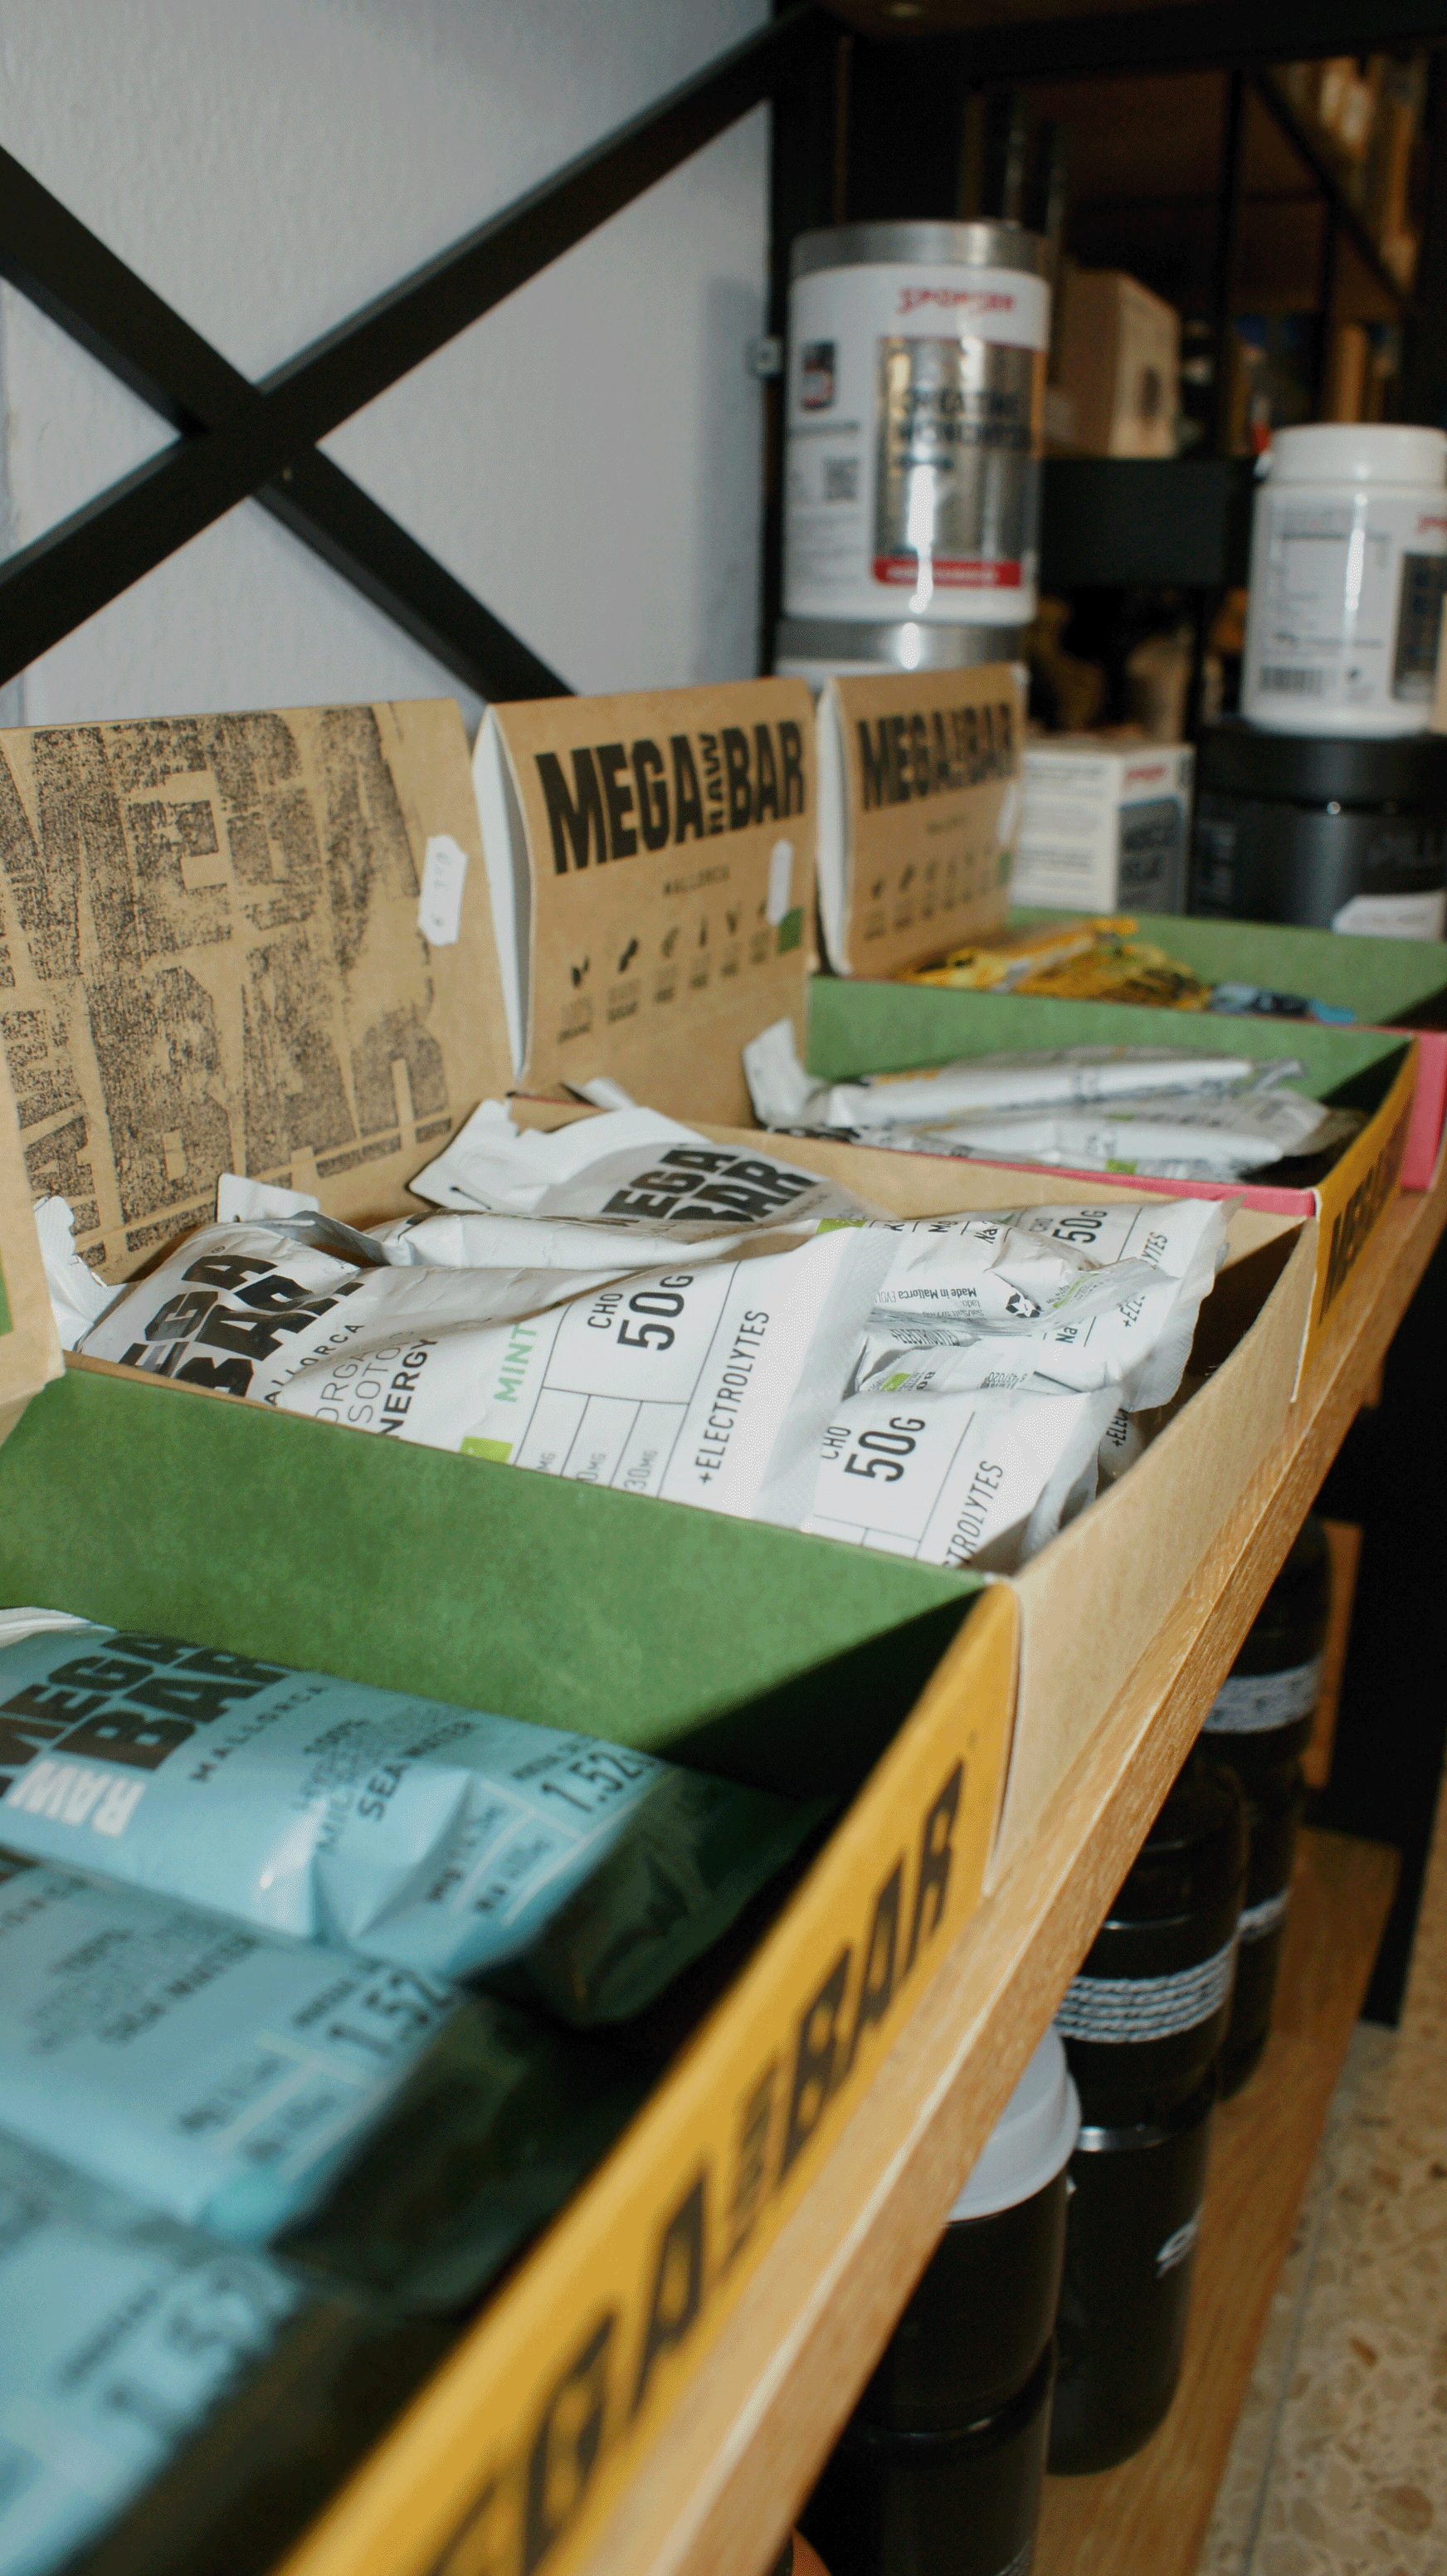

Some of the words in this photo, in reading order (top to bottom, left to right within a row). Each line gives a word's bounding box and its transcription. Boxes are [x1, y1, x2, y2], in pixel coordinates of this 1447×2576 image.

[535, 733, 704, 876] MEGA
[721, 720, 806, 832] BAR
[1050, 1209, 1108, 1244] 50G
[587, 1291, 624, 1329] CHO
[617, 1274, 695, 1352] 50G
[898, 1289, 938, 1300] Mallorca
[939, 1289, 949, 1300] in
[951, 1287, 977, 1299] Made
[493, 1324, 538, 1403] MINT
[1055, 1326, 1079, 1344] Na
[696, 1309, 771, 1486] +ELECTROLYTES
[844, 1415, 927, 1484] 50G
[6, 1759, 146, 1839] RAW
[357, 1761, 412, 1822] SEA
